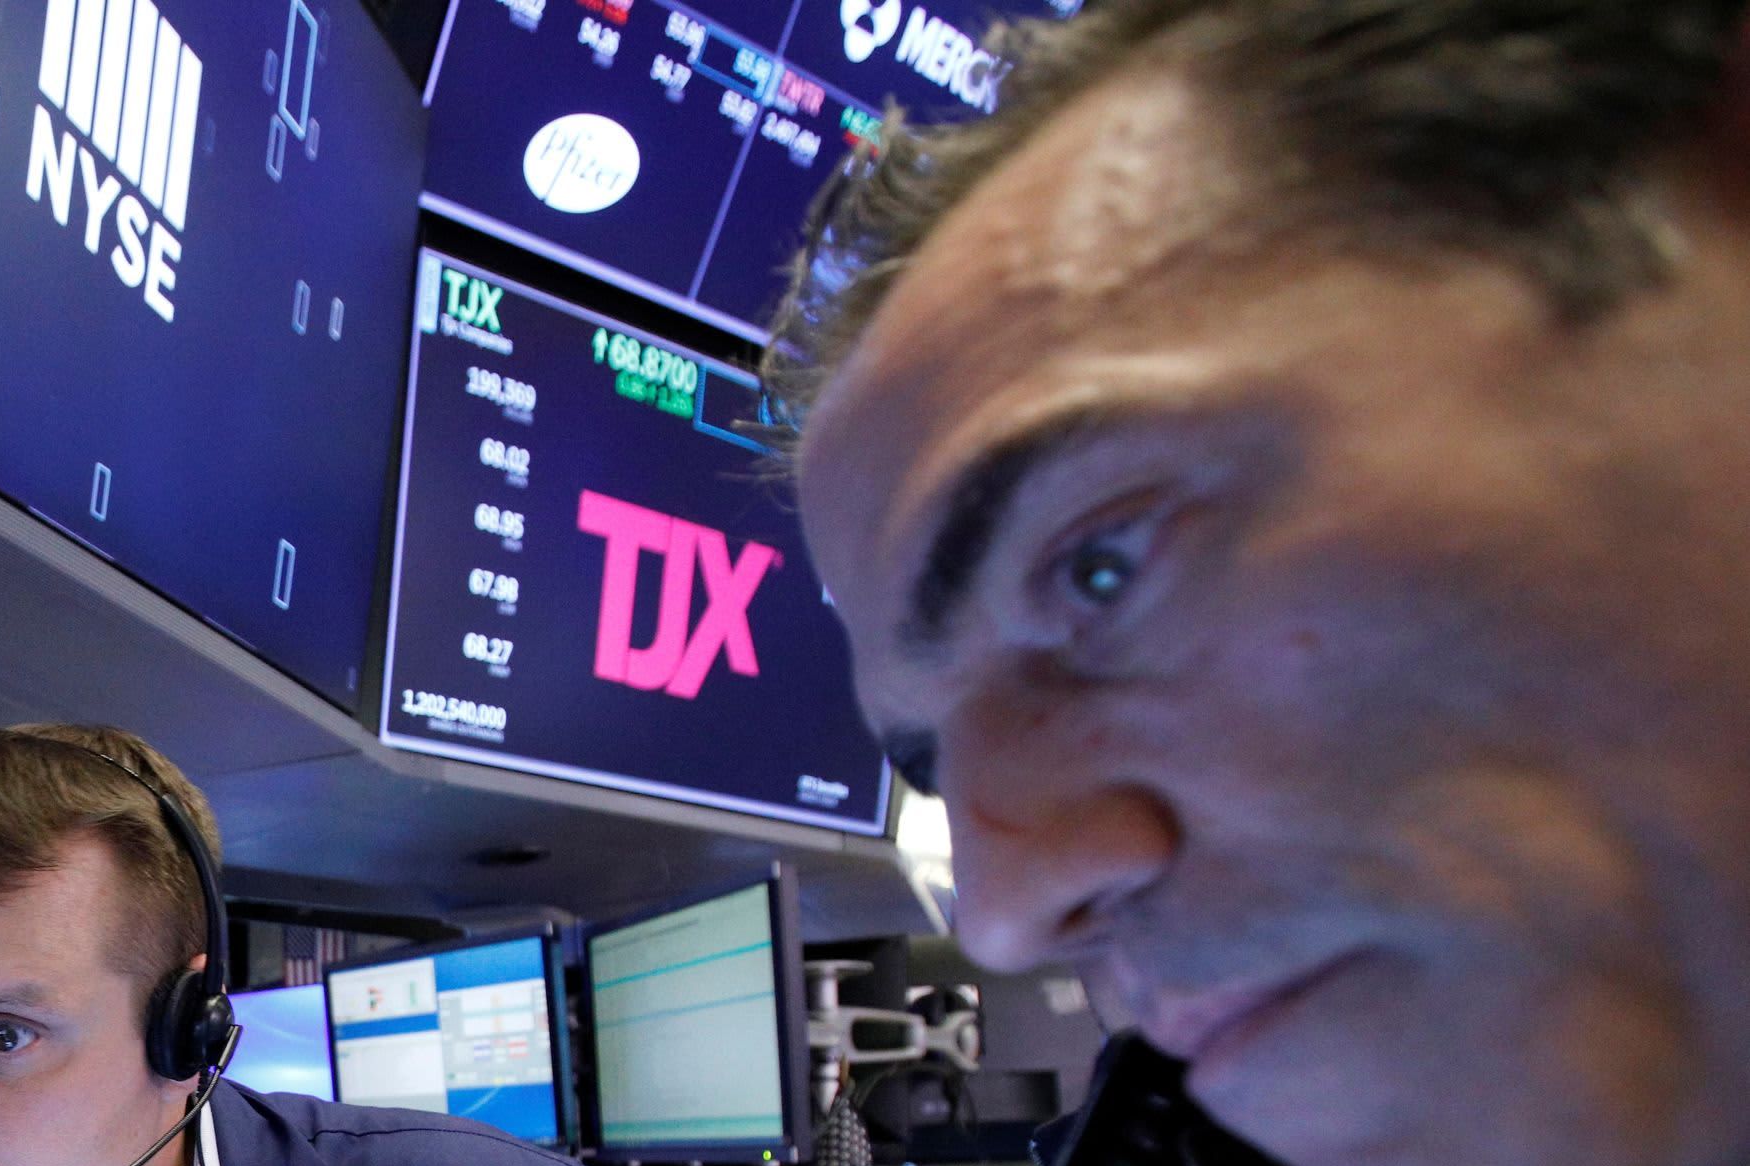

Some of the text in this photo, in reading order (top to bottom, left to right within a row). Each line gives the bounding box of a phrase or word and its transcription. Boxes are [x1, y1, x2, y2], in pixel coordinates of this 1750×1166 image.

[895, 6, 1014, 115] MERCK
[26, 103, 182, 323] NYSE
[443, 268, 504, 333] TJX
[608, 333, 698, 394] 68.8700
[577, 488, 777, 700] TJX
